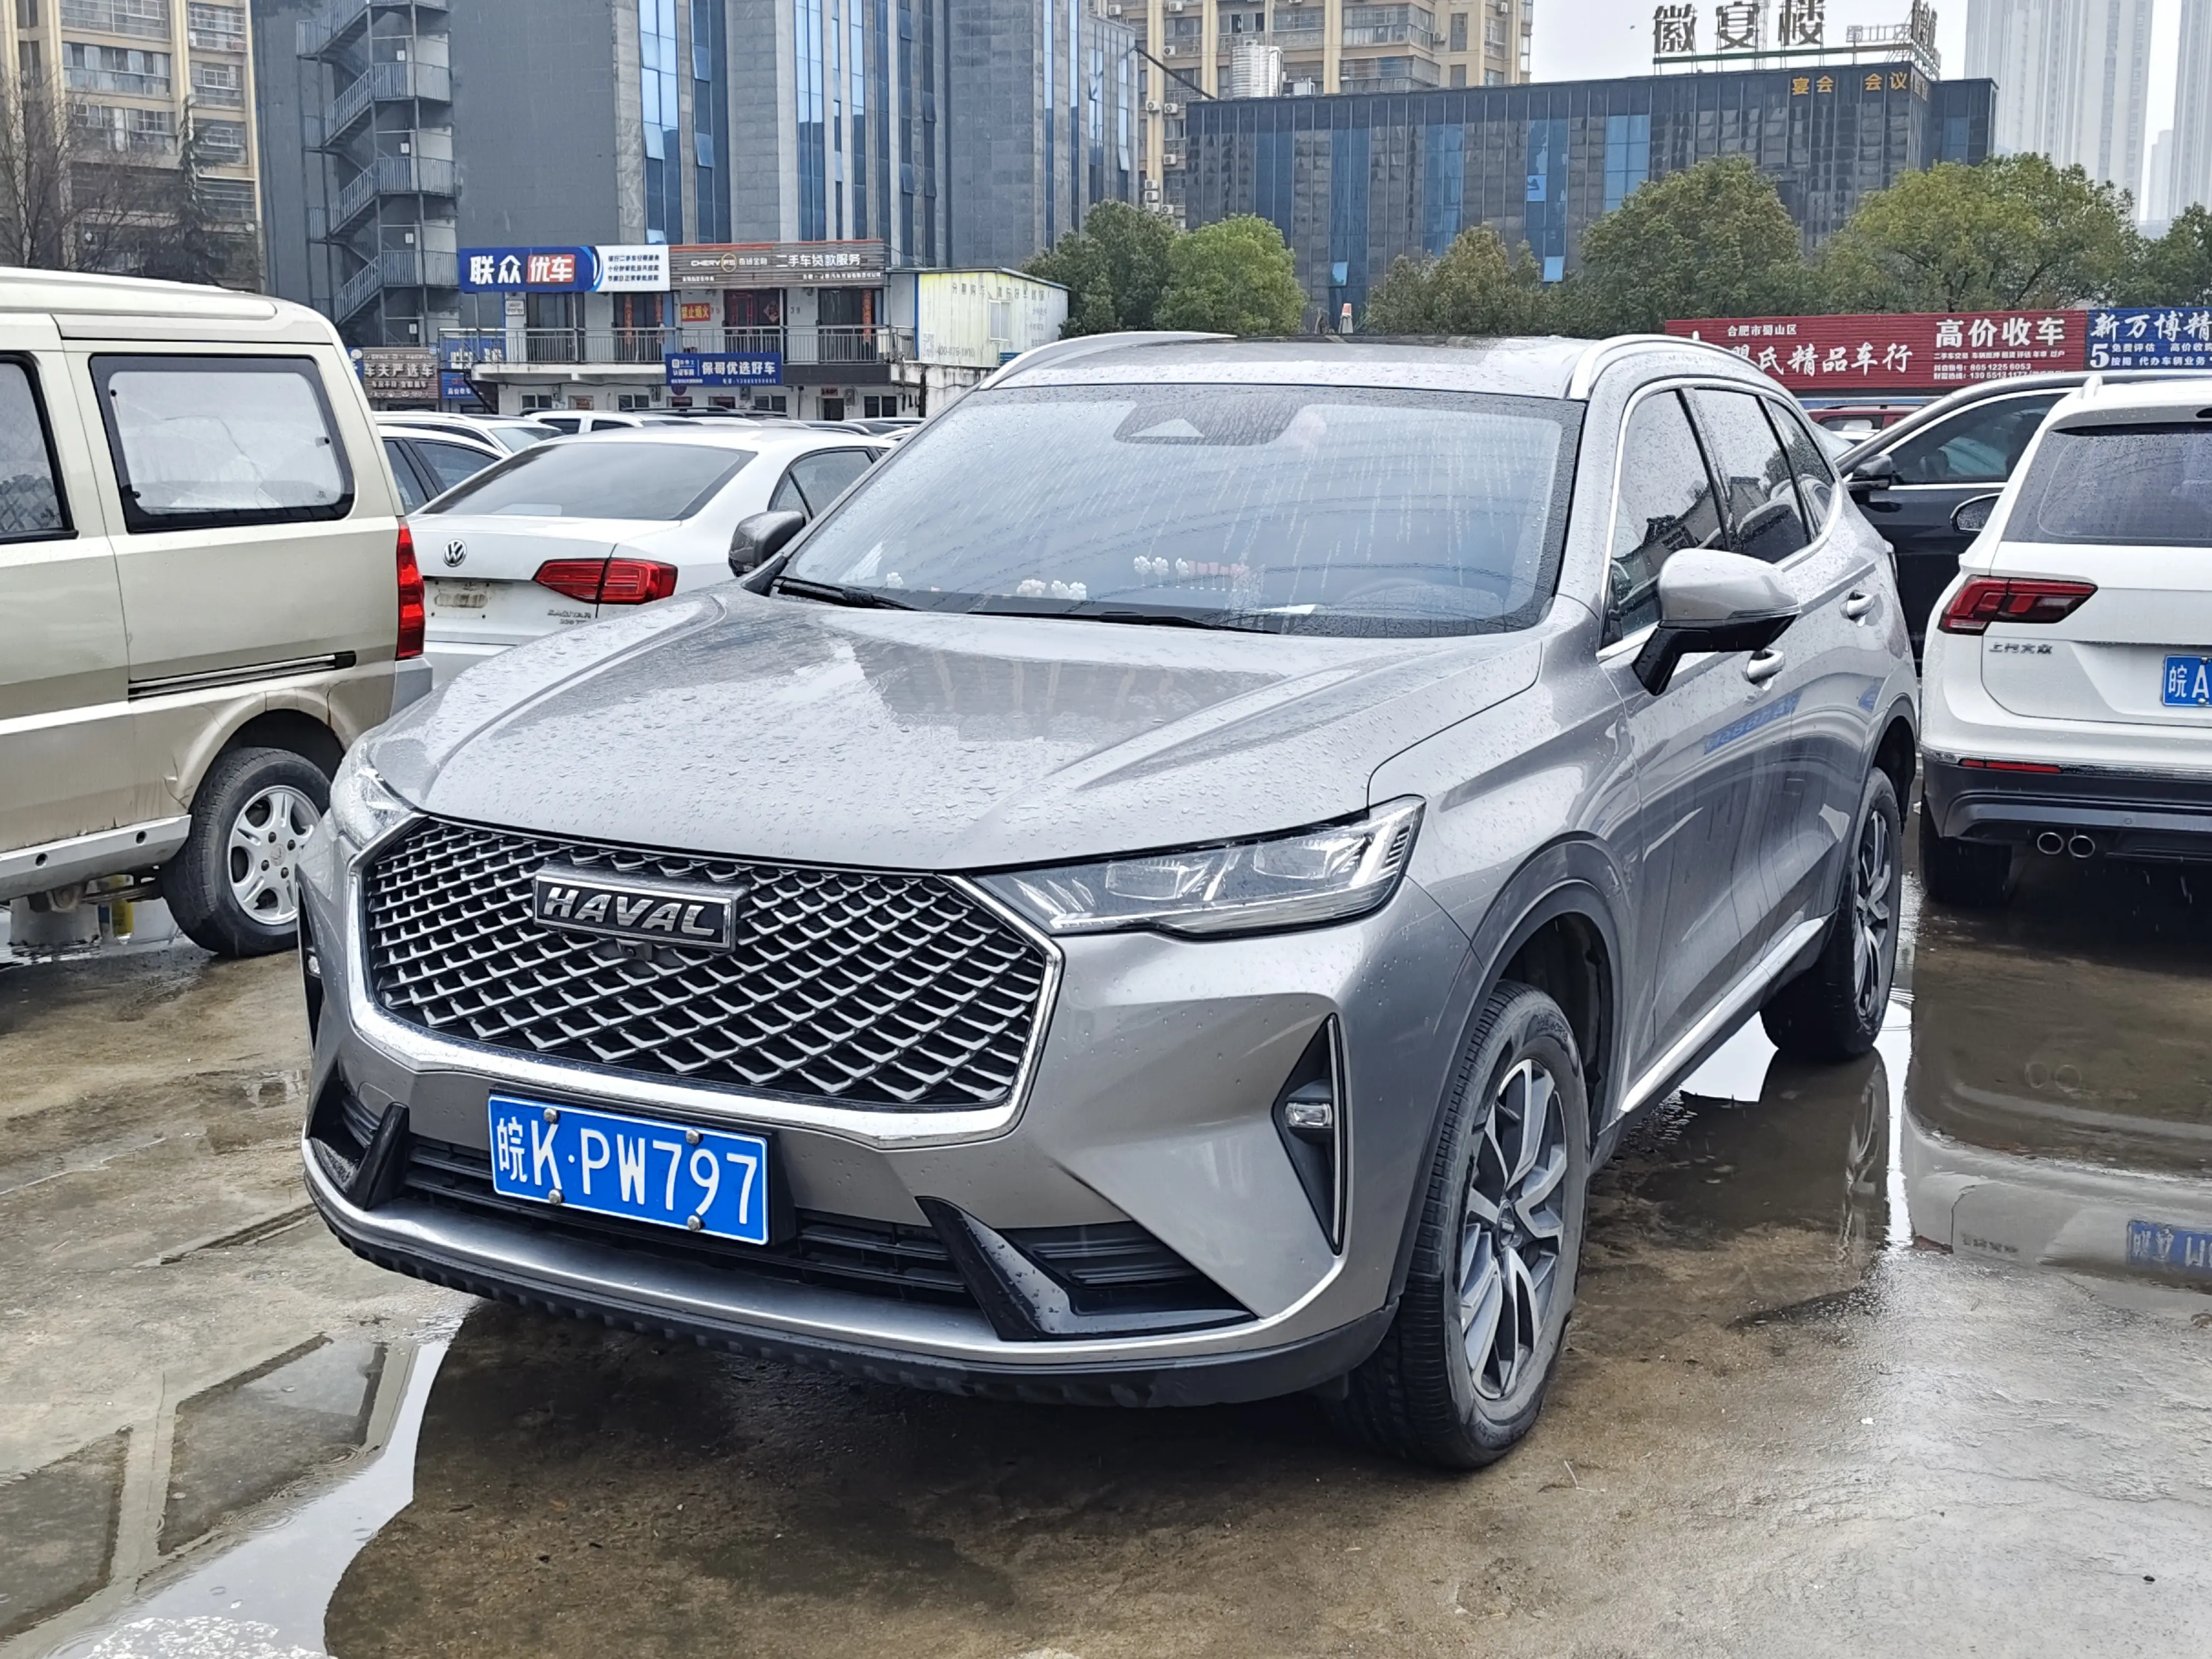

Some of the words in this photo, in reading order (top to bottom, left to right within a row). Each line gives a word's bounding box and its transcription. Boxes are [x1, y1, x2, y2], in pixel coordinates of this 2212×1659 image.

[1792, 77, 1834, 96] 宴会
[1864, 71, 1907, 91] 会议
[469, 254, 573, 285] 联众优车
[776, 253, 861, 267] 二手车贷款服务
[1728, 324, 1797, 337] 合肥市蜀山区
[1936, 316, 2065, 348] 高价收车
[2090, 310, 2212, 342] 新万博精
[2089, 343, 2109, 368] 5
[2112, 342, 2155, 353] 免费评估
[2170, 342, 2212, 353] 高价收购
[364, 363, 434, 377] 车夫严选车
[702, 361, 775, 376] 保哥优选好车
[2139, 356, 2206, 366] 代办车辆业务
[2168, 664, 2210, 698] 皖A
[543, 887, 716, 937] HAVAL
[497, 1116, 758, 1225] 皖K·PW797
